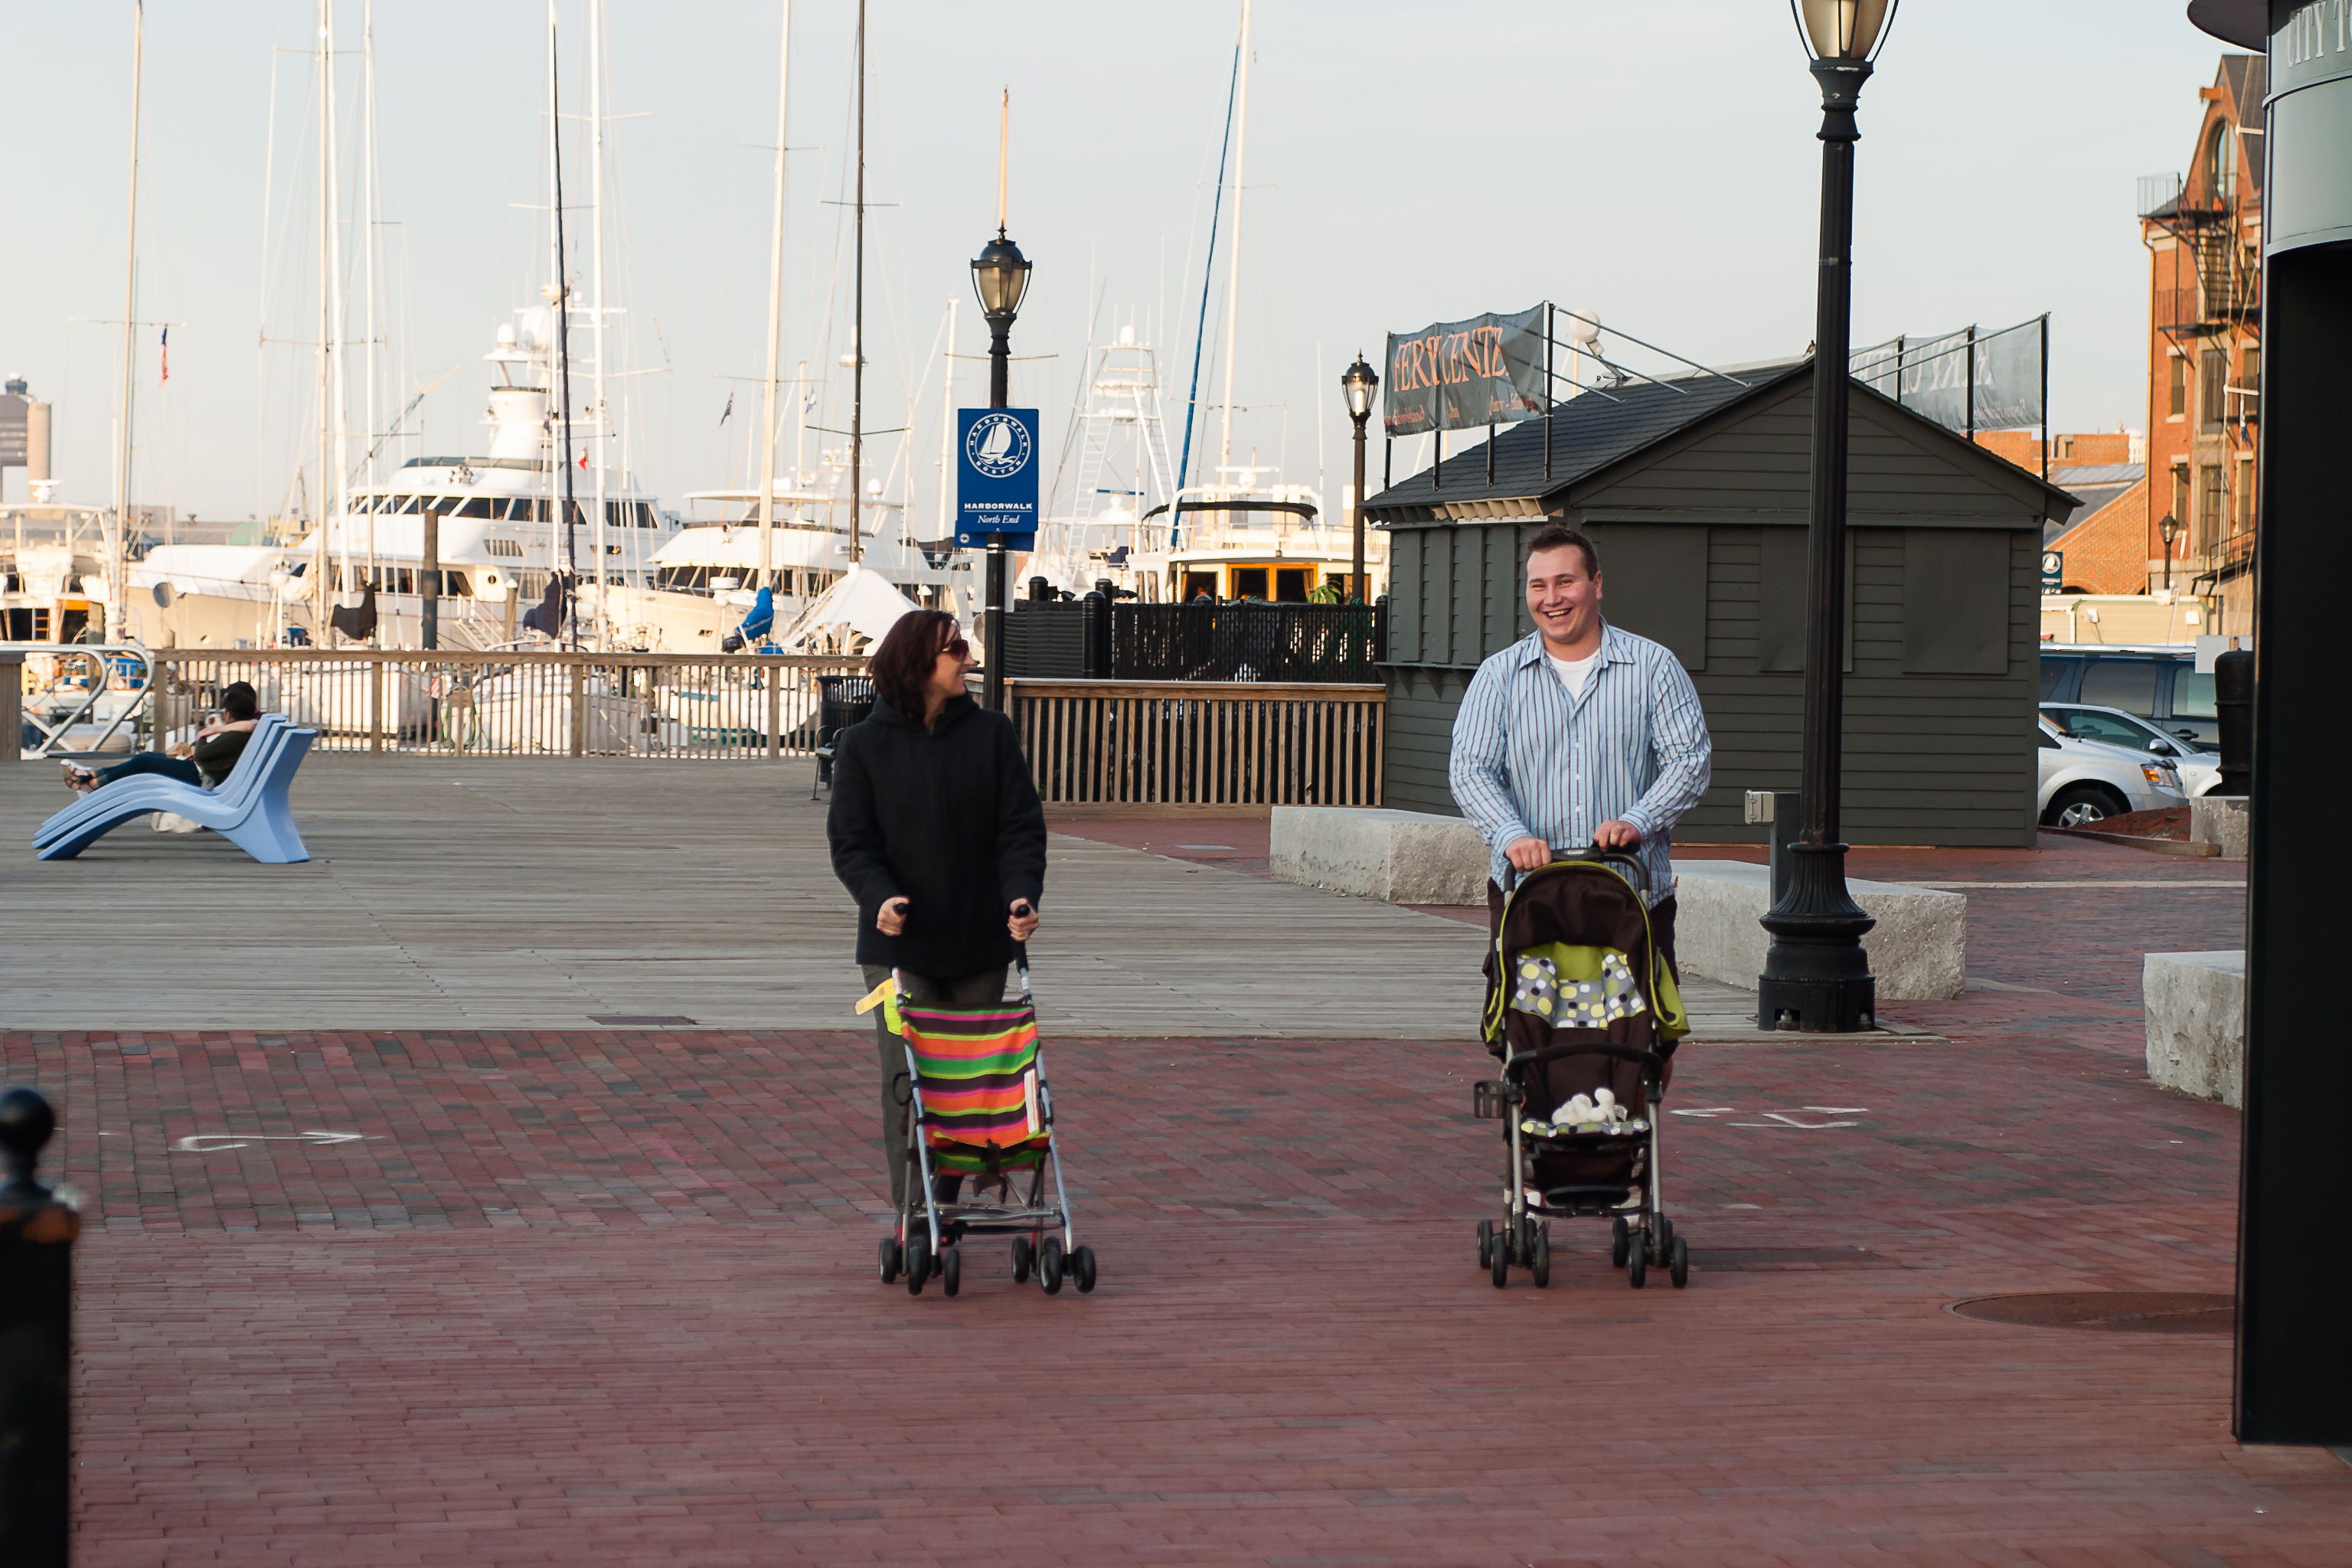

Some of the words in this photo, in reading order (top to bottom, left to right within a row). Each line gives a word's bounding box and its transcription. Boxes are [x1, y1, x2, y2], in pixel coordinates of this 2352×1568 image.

[2287, 2, 2326, 67] CITY
[2334, 0, 2352, 52] T
[969, 416, 1027, 447] HARBORWALK
[976, 461, 1021, 474] BOSTON
[977, 514, 1001, 524] North
[1001, 514, 1020, 524] End
